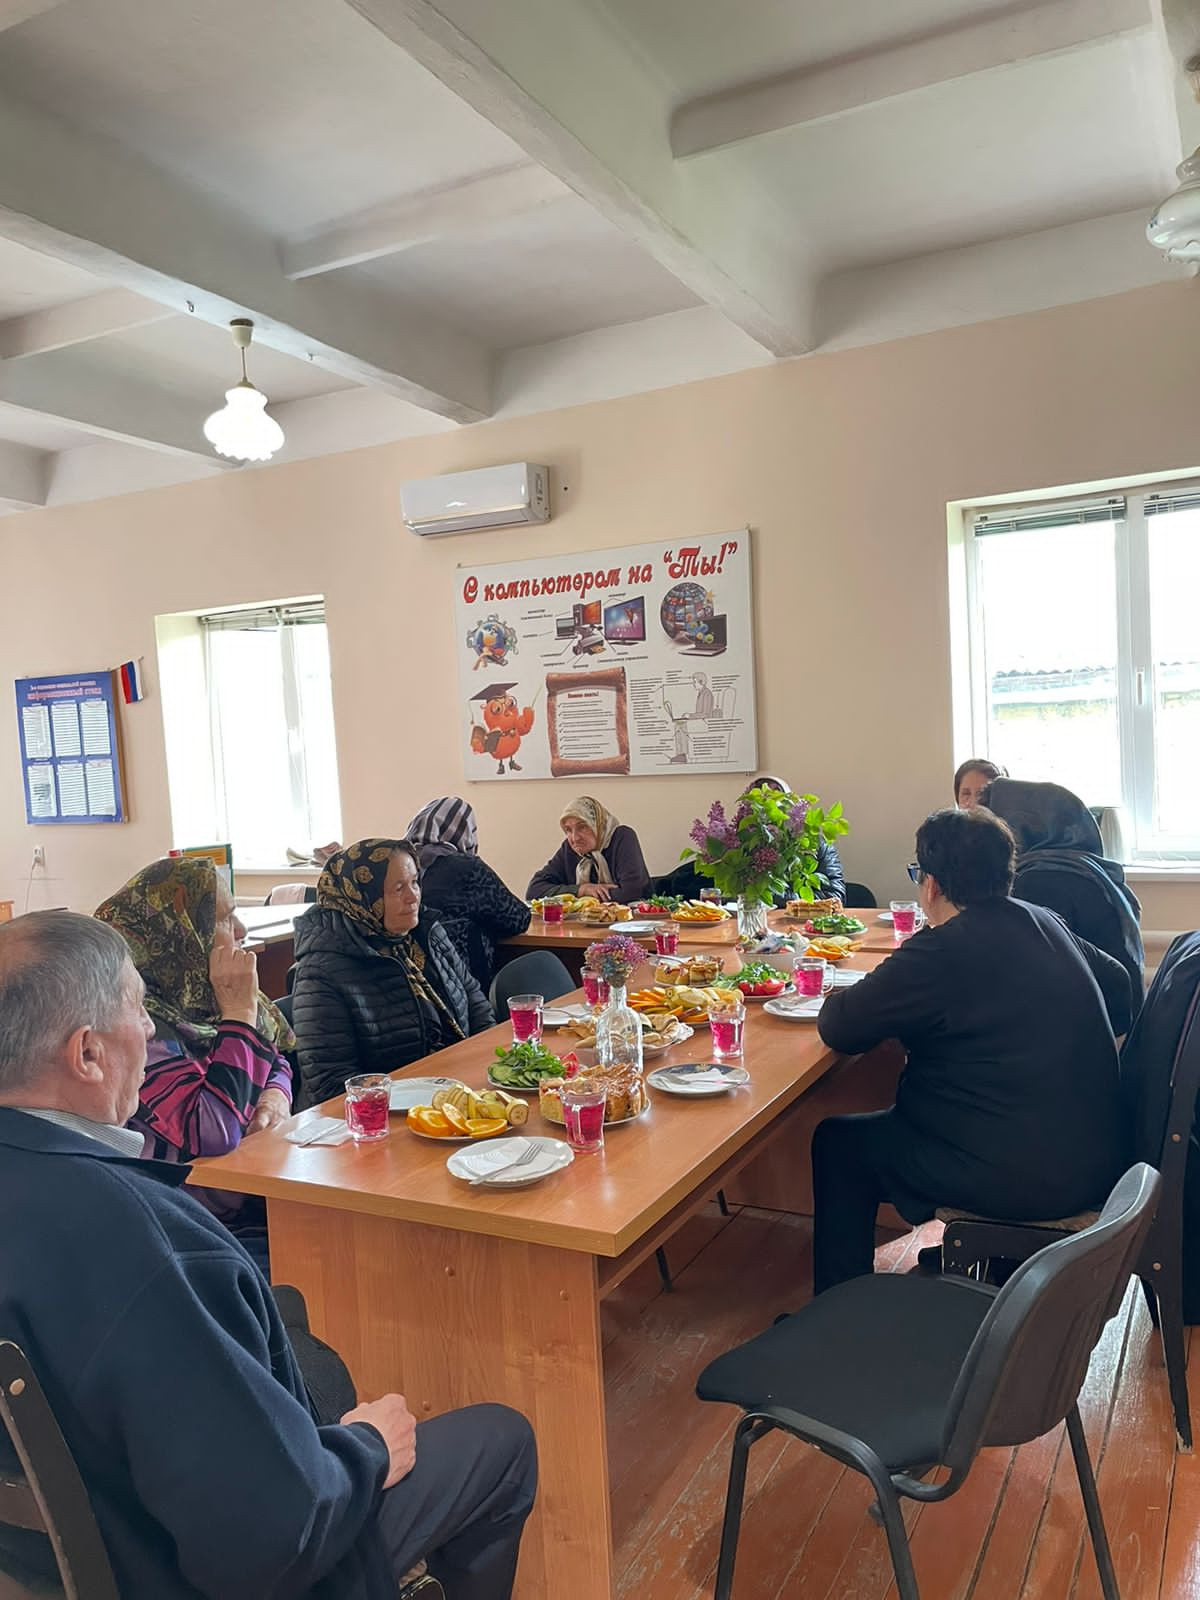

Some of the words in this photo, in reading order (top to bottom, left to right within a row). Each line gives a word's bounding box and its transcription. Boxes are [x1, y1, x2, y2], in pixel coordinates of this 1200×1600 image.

[463, 576, 478, 603] С
[484, 568, 621, 600] компьютером
[628, 563, 653, 584] на
